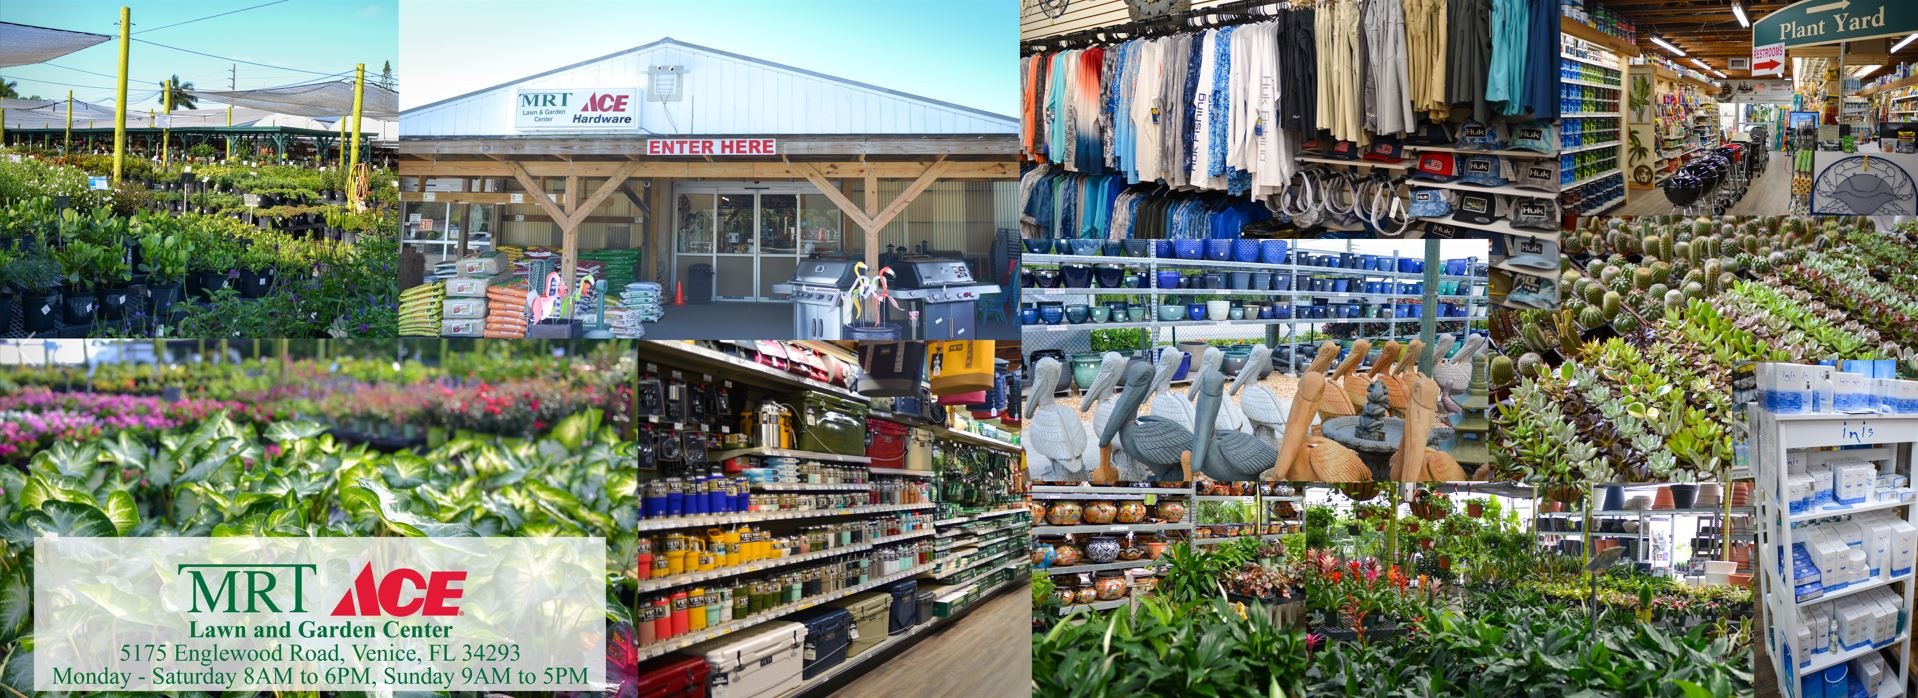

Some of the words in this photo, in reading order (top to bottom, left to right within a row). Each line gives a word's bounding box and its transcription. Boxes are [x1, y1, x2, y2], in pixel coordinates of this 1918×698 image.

[1779, 20, 1826, 40] Plant
[1832, 6, 1886, 33] Yard
[1753, 45, 1783, 60] RESTROOMS
[518, 93, 573, 107] MRT
[580, 92, 629, 112] ACE
[572, 114, 632, 124] Hardware
[1466, 128, 1486, 136] Huk
[1521, 130, 1540, 138] Huk
[649, 140, 714, 155] ENTER
[720, 139, 775, 154] HERE
[1470, 163, 1488, 171] Huk
[1529, 169, 1550, 178] Huk
[1522, 207, 1544, 215] Huk
[1842, 420, 1874, 443] inis
